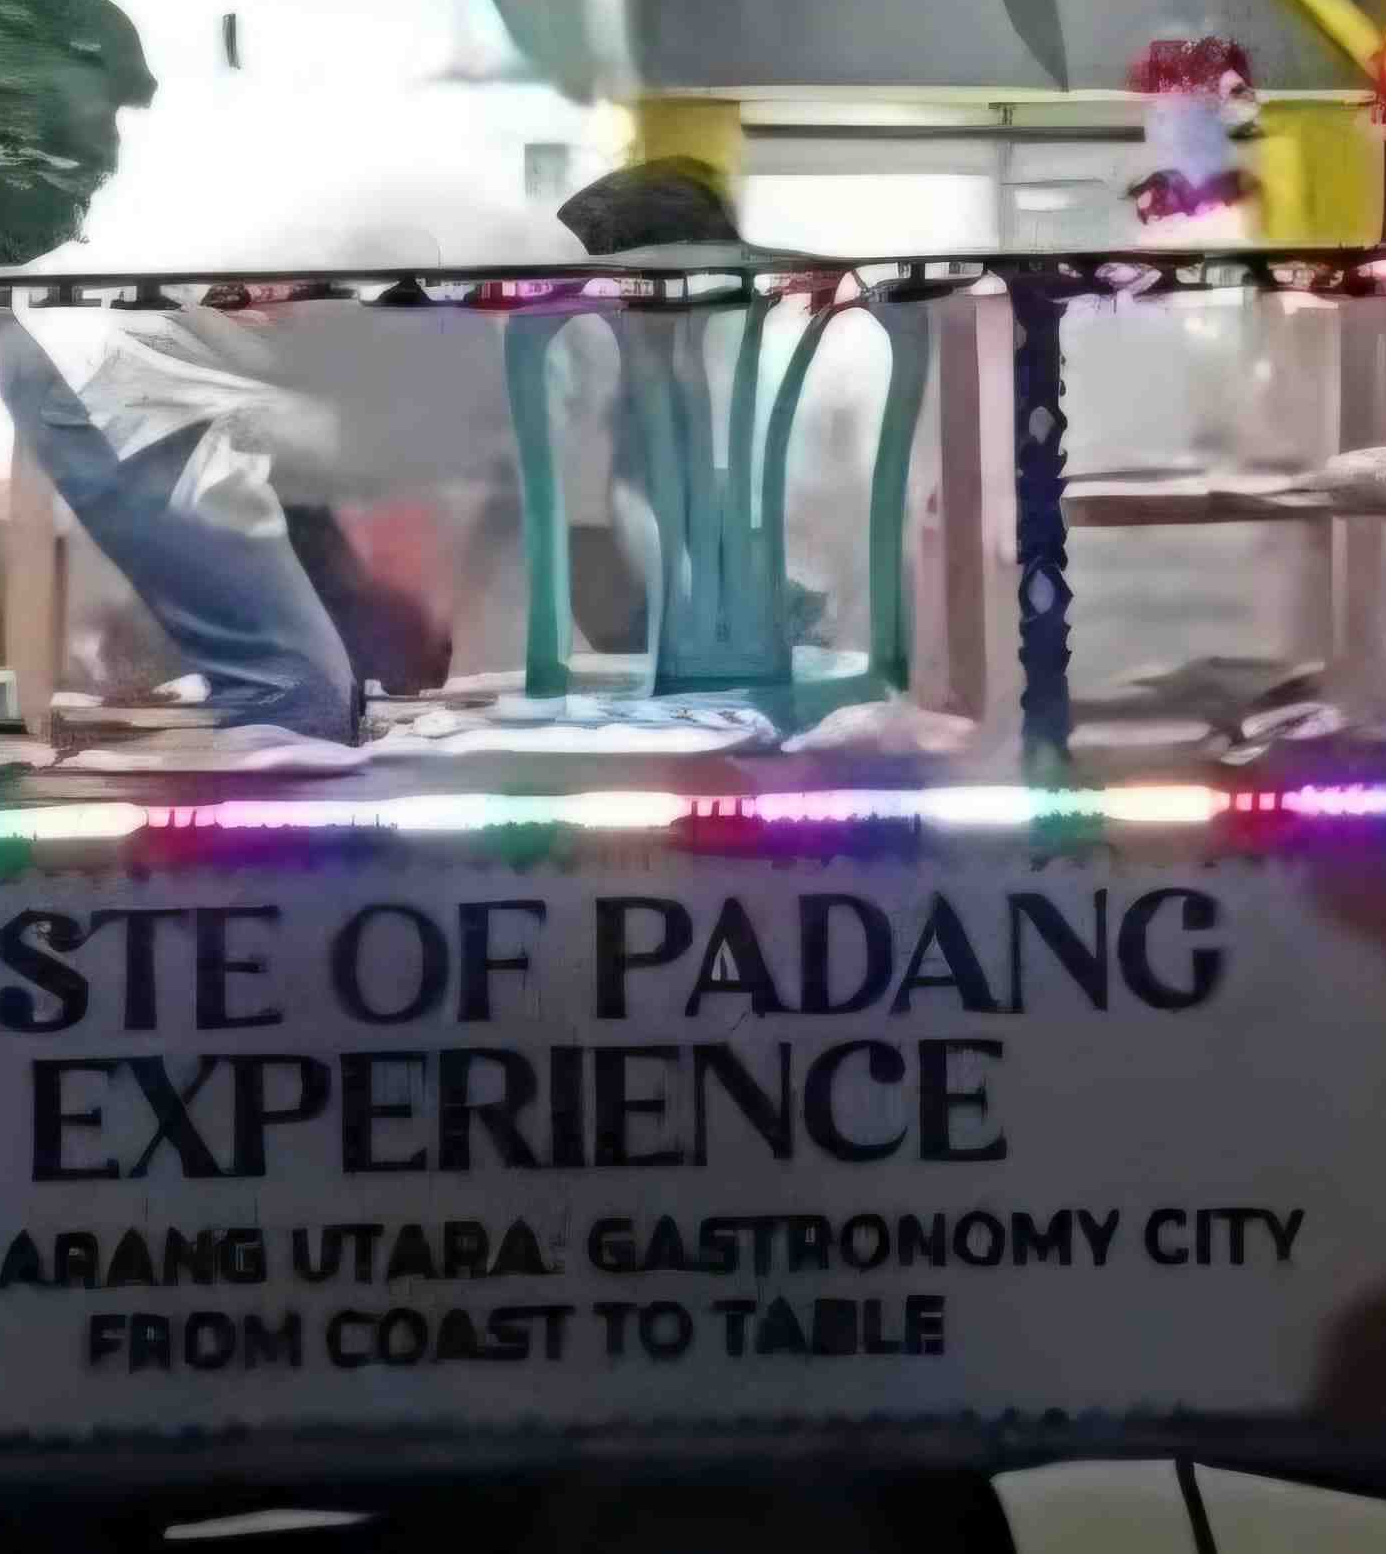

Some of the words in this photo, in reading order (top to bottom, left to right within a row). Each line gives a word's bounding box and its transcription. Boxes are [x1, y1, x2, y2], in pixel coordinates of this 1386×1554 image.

[332, 900, 547, 1026] OF
[595, 887, 1228, 1019] PADANG
[30, 1038, 1008, 1182] EXPERIENCE
[587, 1208, 1122, 1275] GASTRONOMY
[1144, 1206, 1307, 1267] CITY
[88, 1312, 302, 1373] FROM
[325, 1304, 575, 1369] COAST
[593, 1301, 695, 1360] TO
[714, 1294, 946, 1358] TABLE
